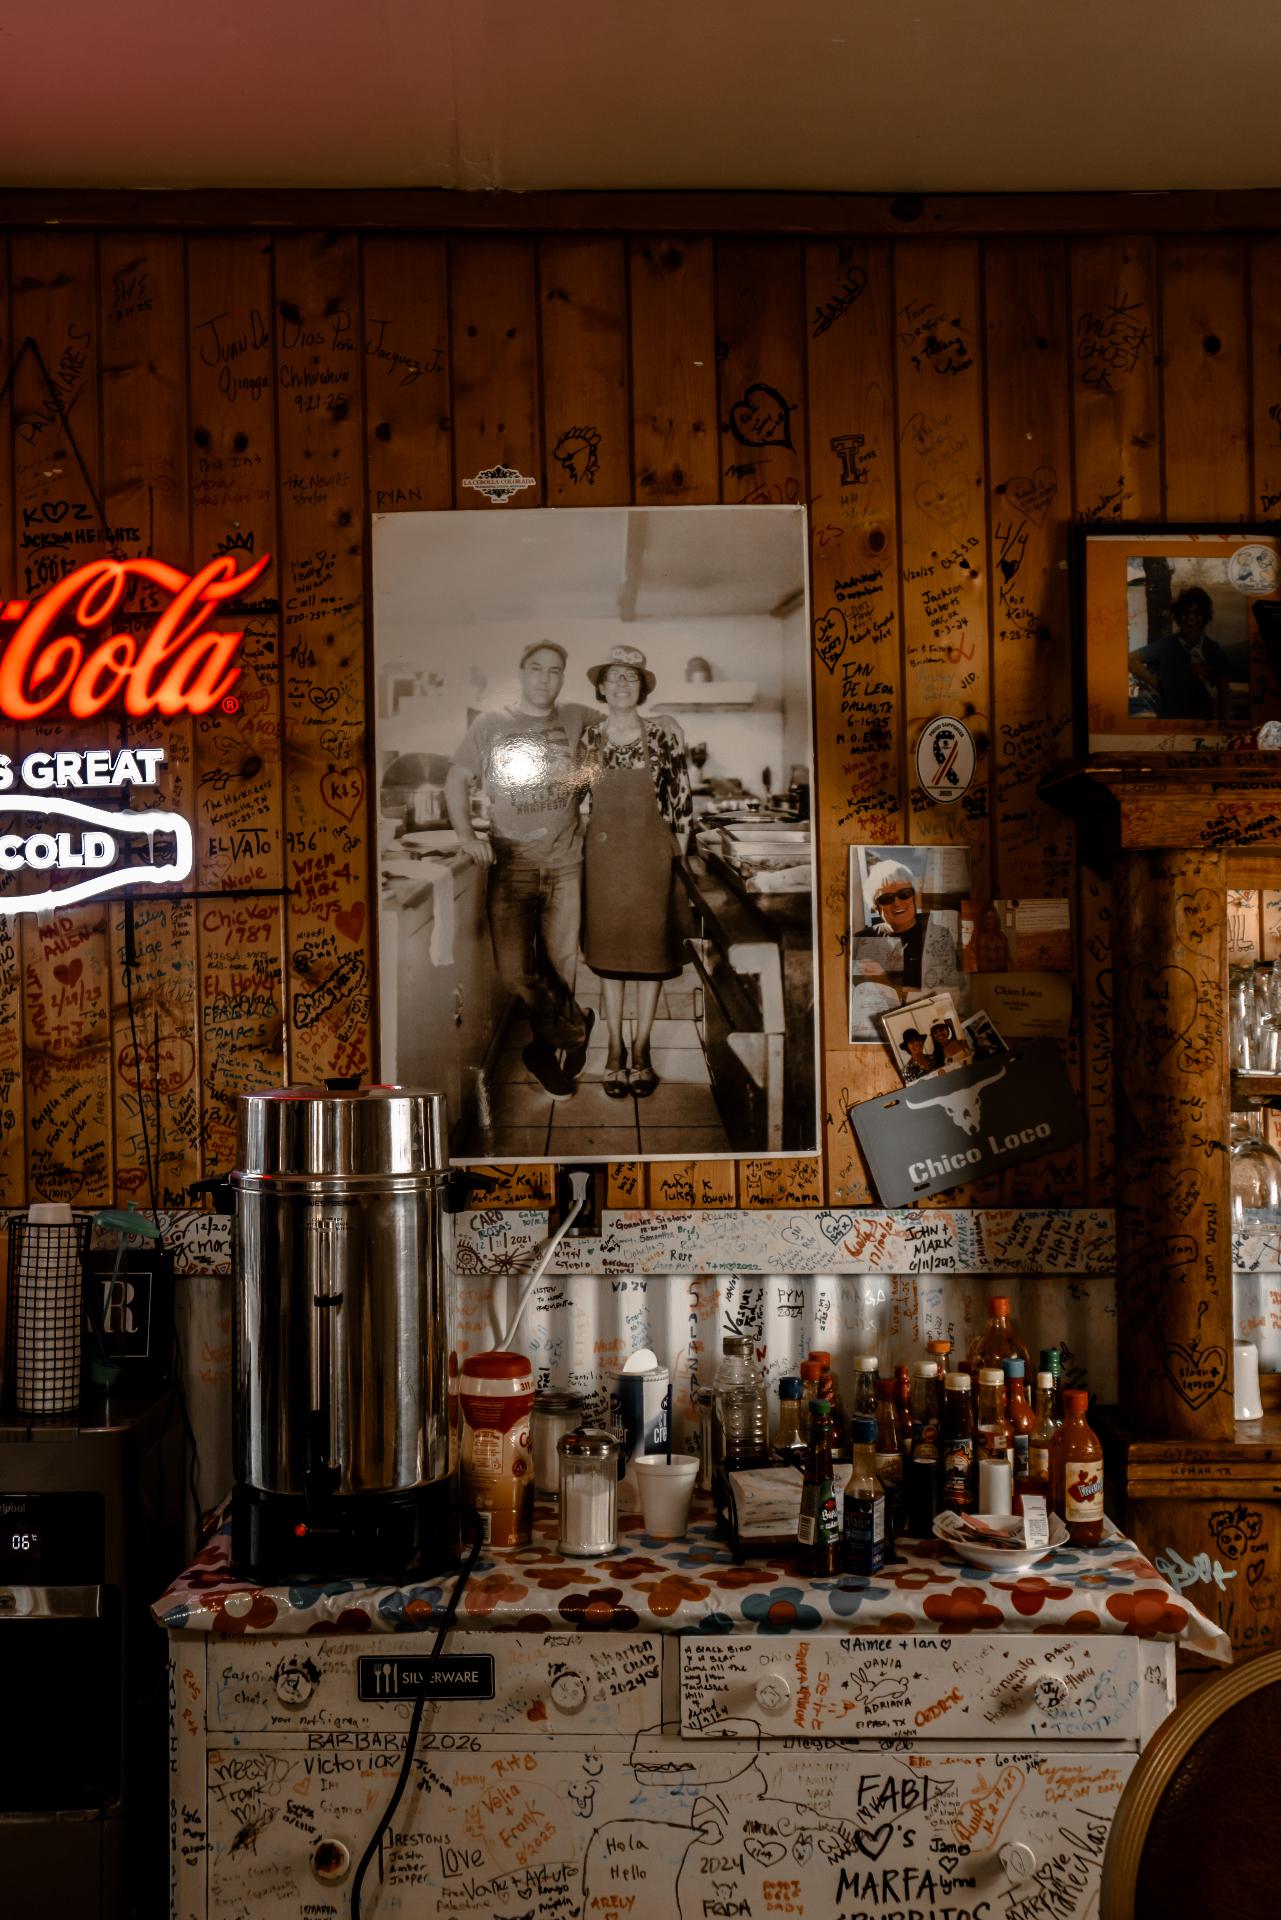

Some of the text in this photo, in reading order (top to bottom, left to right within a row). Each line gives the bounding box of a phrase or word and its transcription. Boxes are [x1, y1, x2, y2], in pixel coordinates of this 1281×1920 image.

[922, 583, 964, 605] Jackson
[21, 746, 165, 789] GREAT
[203, 798, 222, 813] The
[0, 832, 116, 870] COLD
[221, 867, 267, 892] Nicole
[203, 904, 279, 932] Chicken
[225, 924, 271, 947] 1989
[907, 1120, 1054, 1186] Chico Loco
[470, 1209, 504, 1230] CARO
[904, 1225, 938, 1243] JOHN
[913, 1237, 953, 1256] MARK
[853, 1638, 893, 1651] Aimee
[913, 1639, 938, 1650] Ian
[622, 1654, 657, 1675] Club
[864, 1658, 902, 1671] DANIA
[864, 1697, 912, 1717] ADRIANA
[308, 1731, 482, 1751] BARBARA 2026
[857, 1774, 929, 1813] FABI
[606, 1833, 650, 1855] Hola
[930, 1837, 972, 1856] James
[389, 1863, 427, 1874] Amber
[610, 1863, 647, 1881] Hello
[836, 1868, 939, 1905] MARFA
